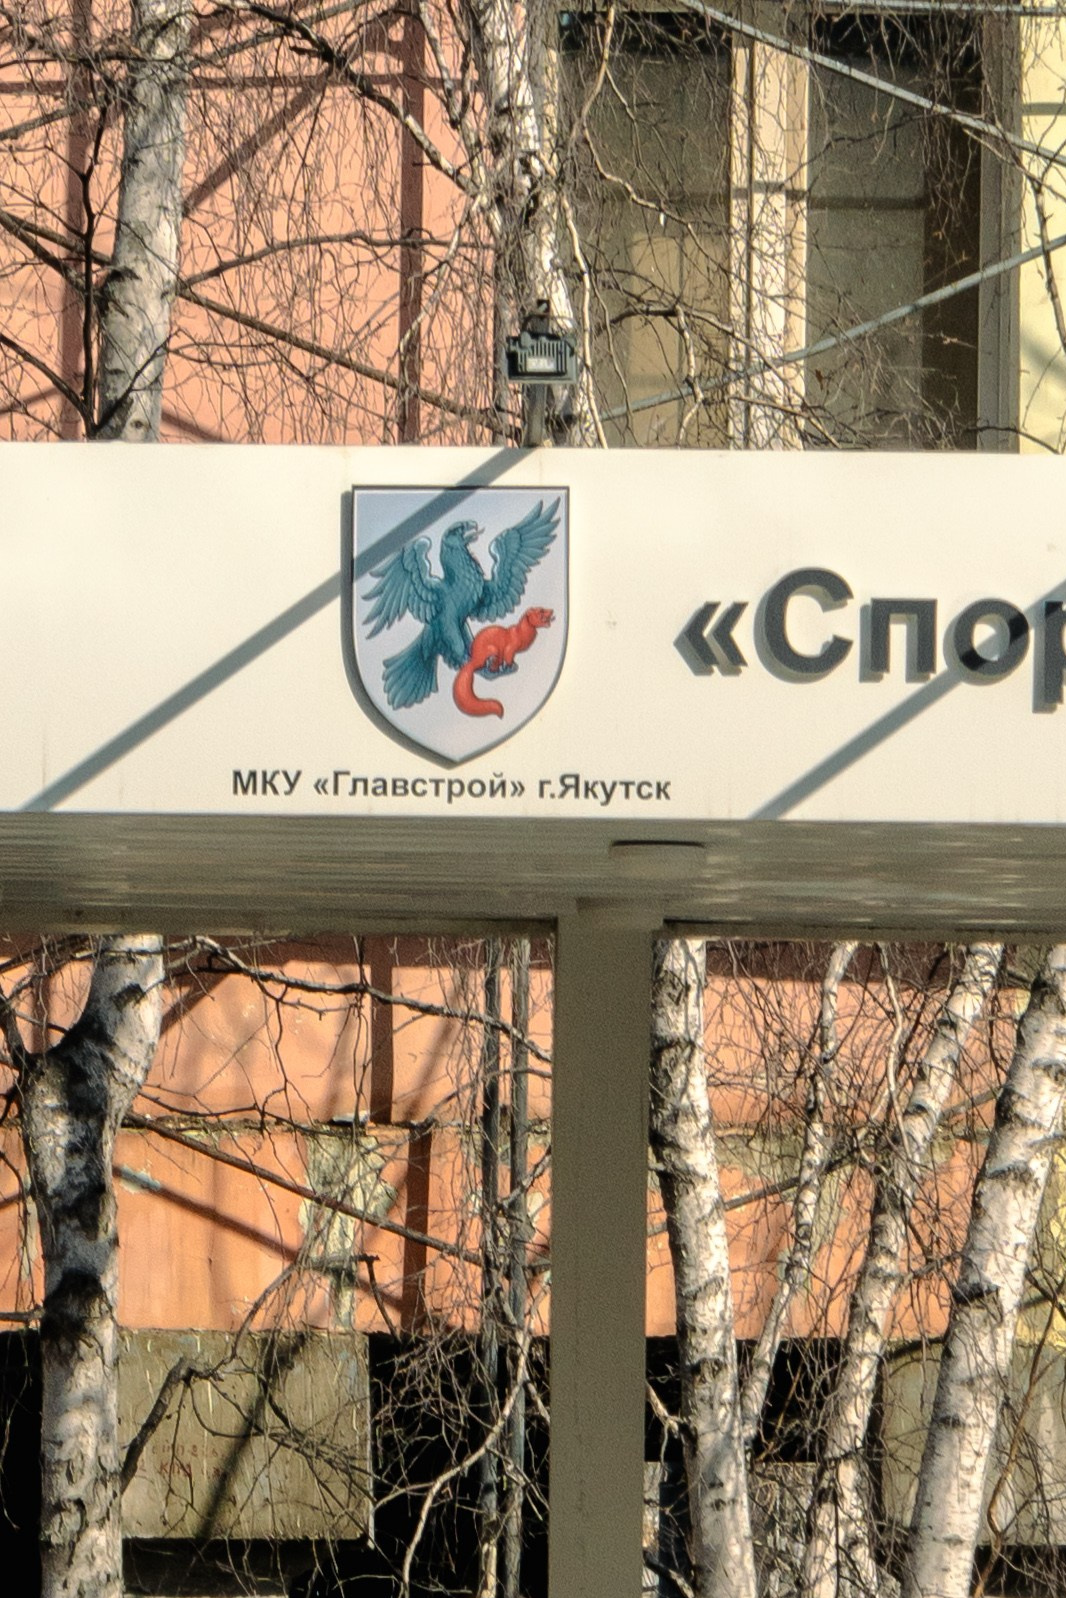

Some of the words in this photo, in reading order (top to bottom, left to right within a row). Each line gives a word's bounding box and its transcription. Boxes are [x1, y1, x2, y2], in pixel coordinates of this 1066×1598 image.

[232, 769, 301, 796] МКУ
[313, 771, 526, 804] «Главстрой»
[538, 773, 672, 806] г.Якутск
